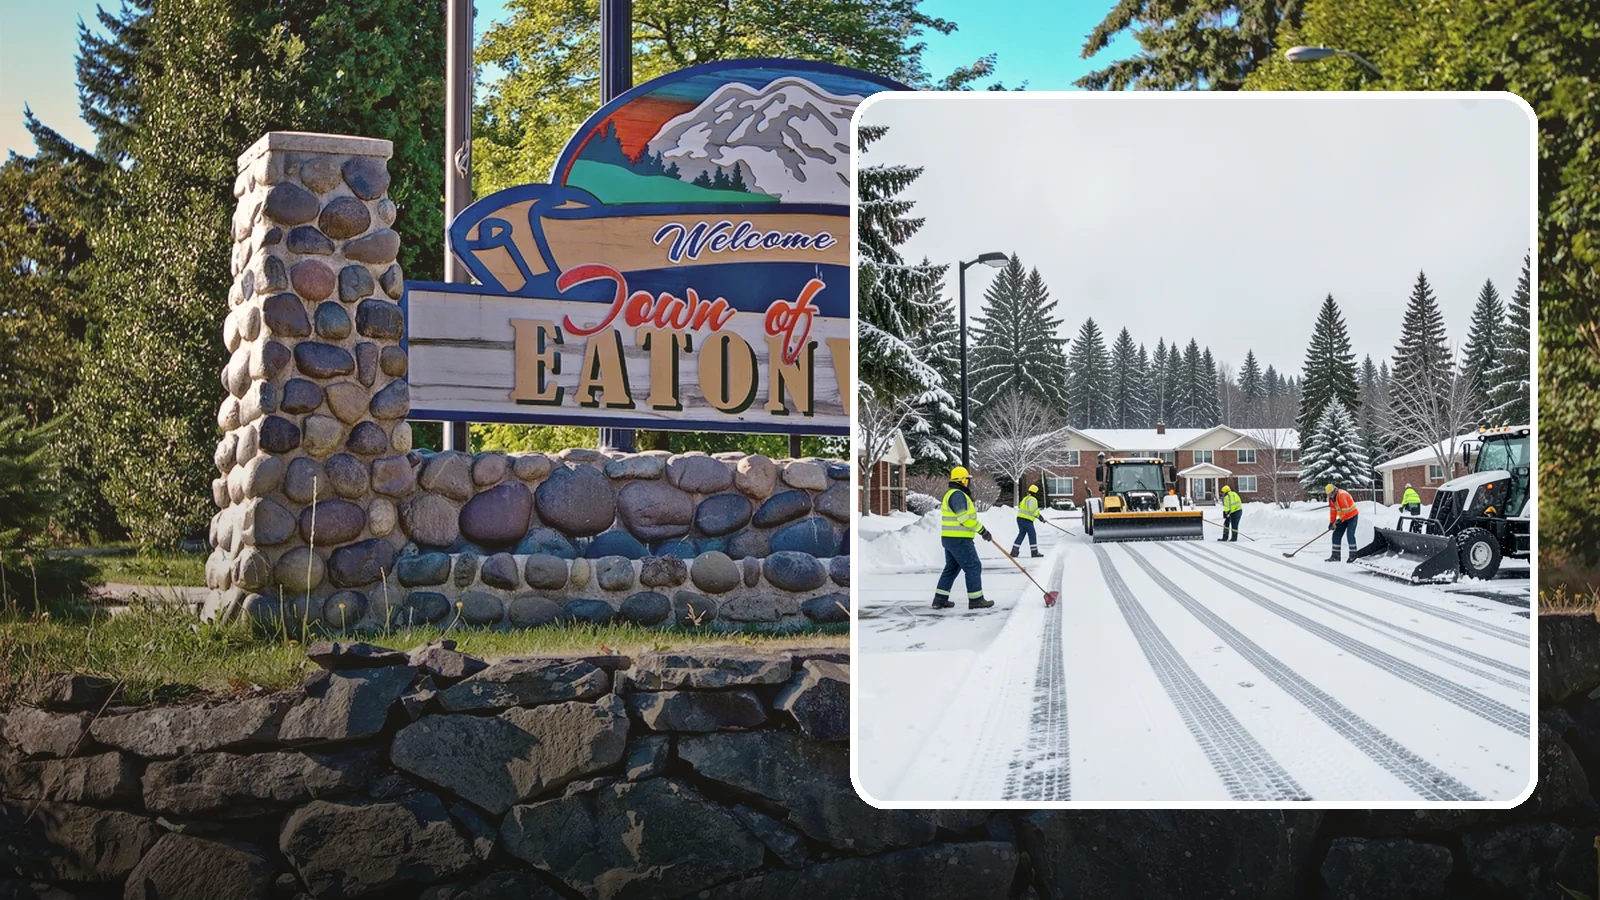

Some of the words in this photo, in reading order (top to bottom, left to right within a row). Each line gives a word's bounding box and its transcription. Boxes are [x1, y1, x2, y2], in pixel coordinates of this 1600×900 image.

[653, 220, 836, 263] Welcome
[557, 264, 735, 335] Town
[764, 278, 826, 365] of
